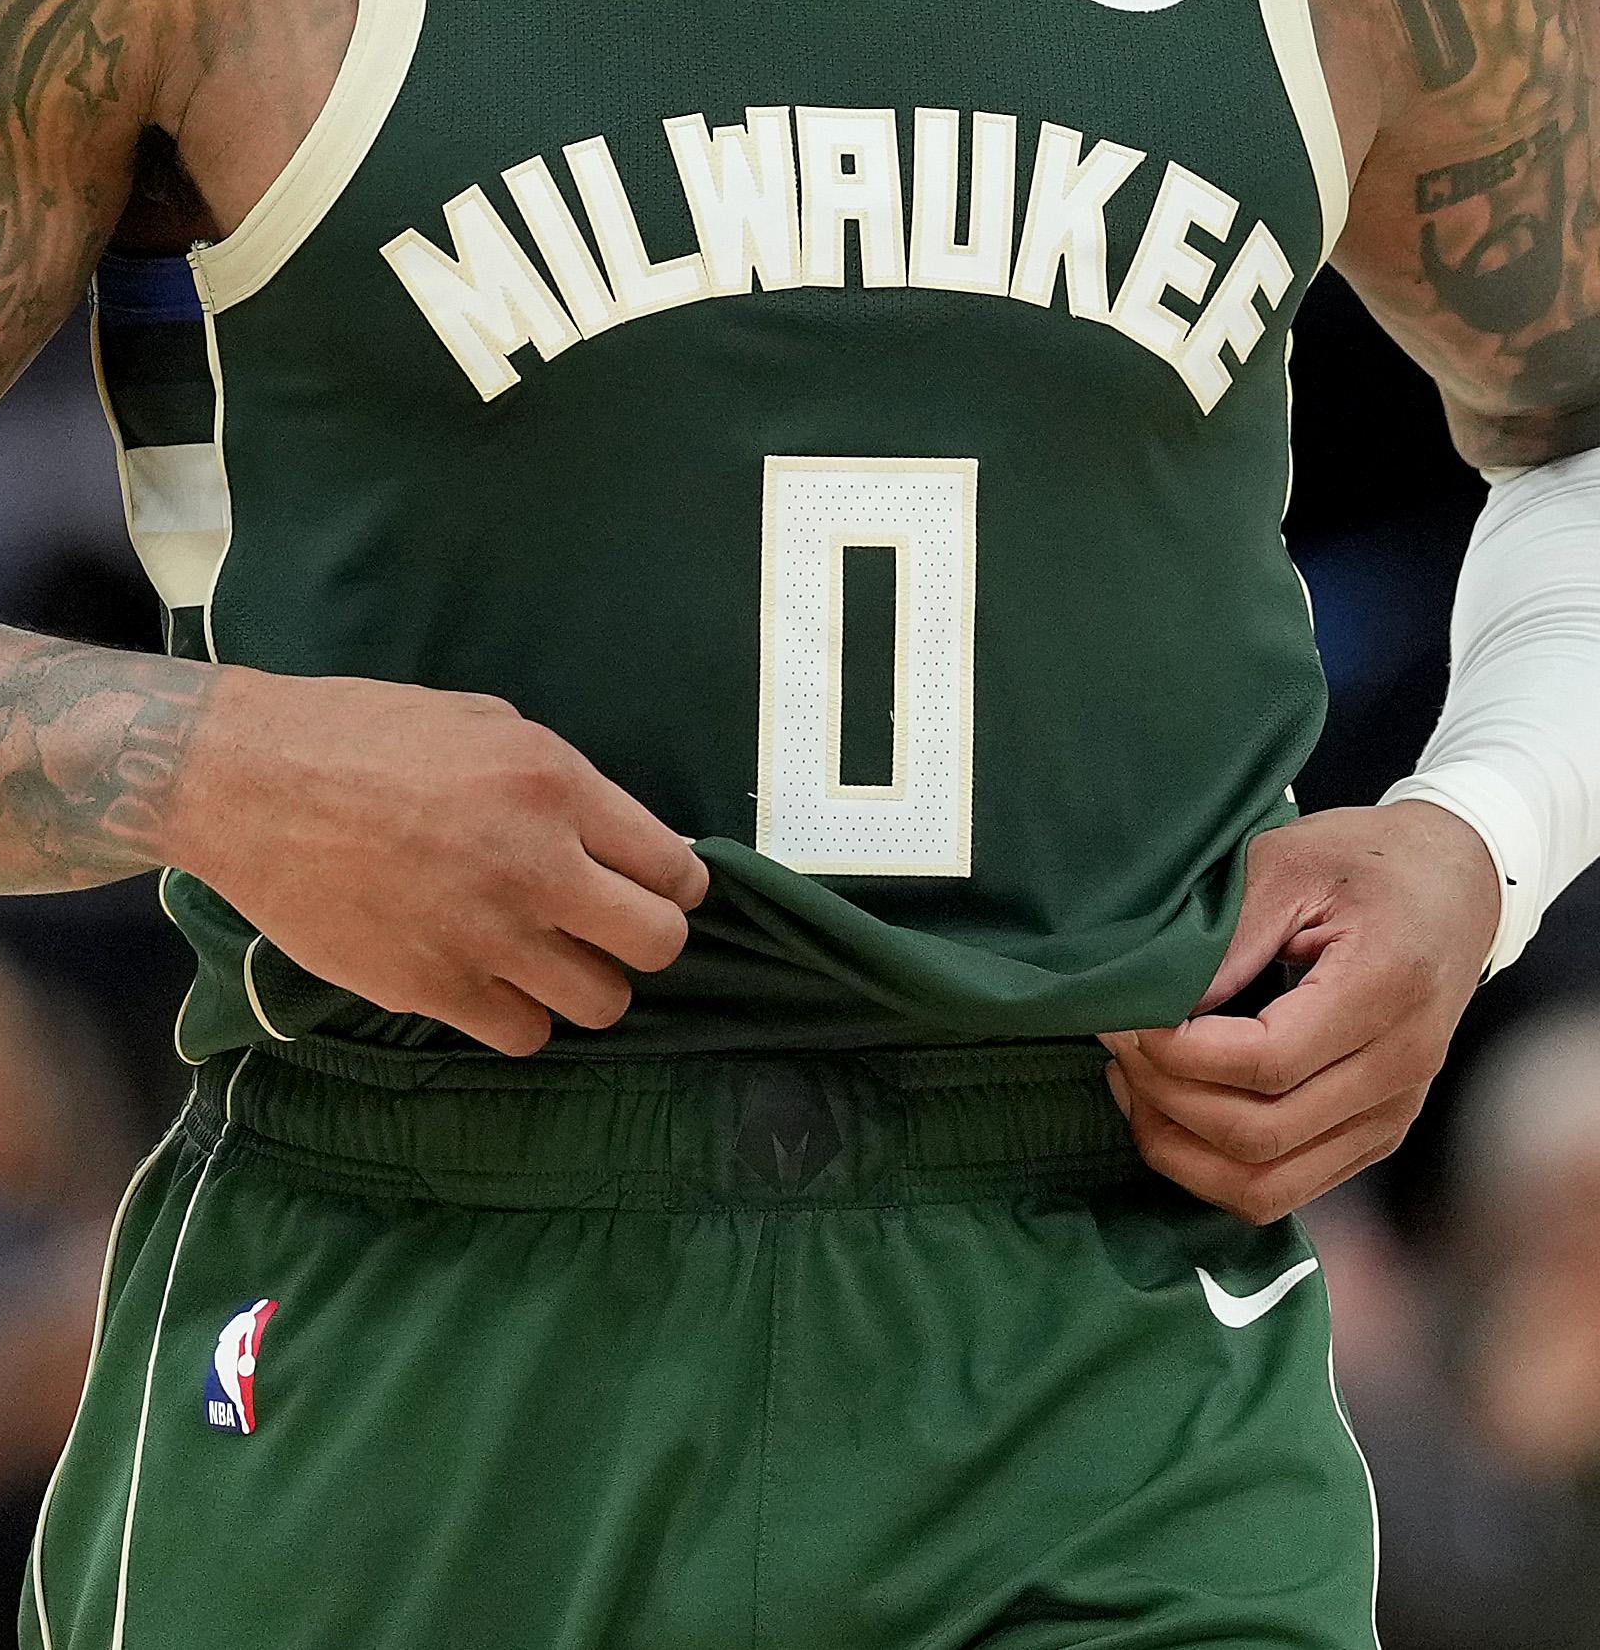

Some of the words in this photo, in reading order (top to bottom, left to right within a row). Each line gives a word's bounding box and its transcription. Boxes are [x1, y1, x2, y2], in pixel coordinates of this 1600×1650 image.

[379, 106, 1294, 416] MILWAUKEE
[756, 455, 979, 878] 0
[208, 1400, 236, 1428] NBA
